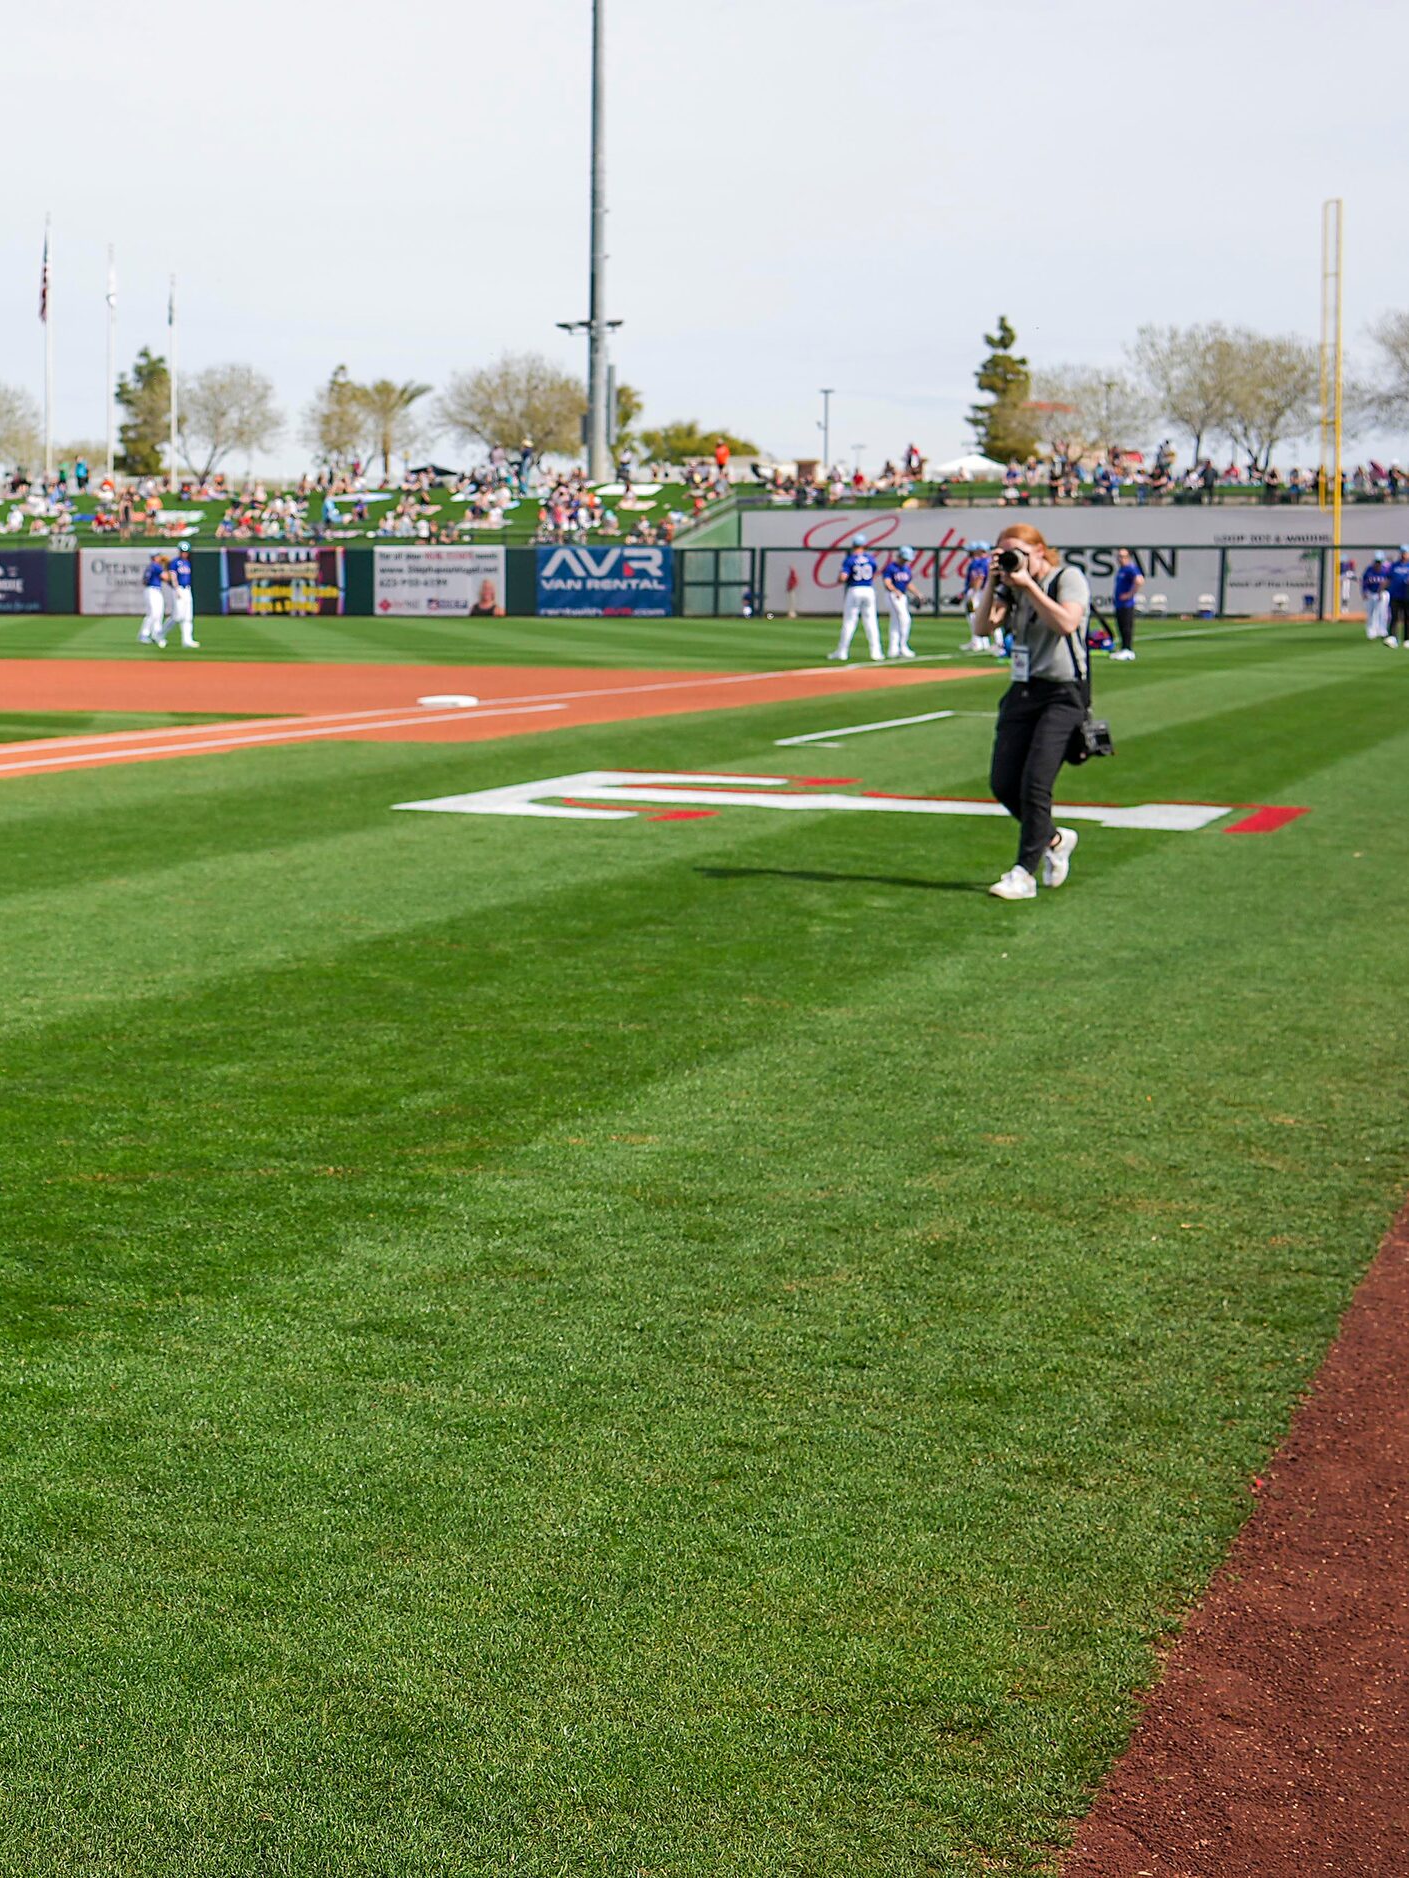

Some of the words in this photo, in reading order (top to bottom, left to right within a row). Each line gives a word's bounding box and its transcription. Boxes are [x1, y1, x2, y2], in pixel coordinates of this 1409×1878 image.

[541, 547, 664, 577] AVR
[541, 579, 582, 591] VAN
[586, 579, 666, 591] RENTAL
